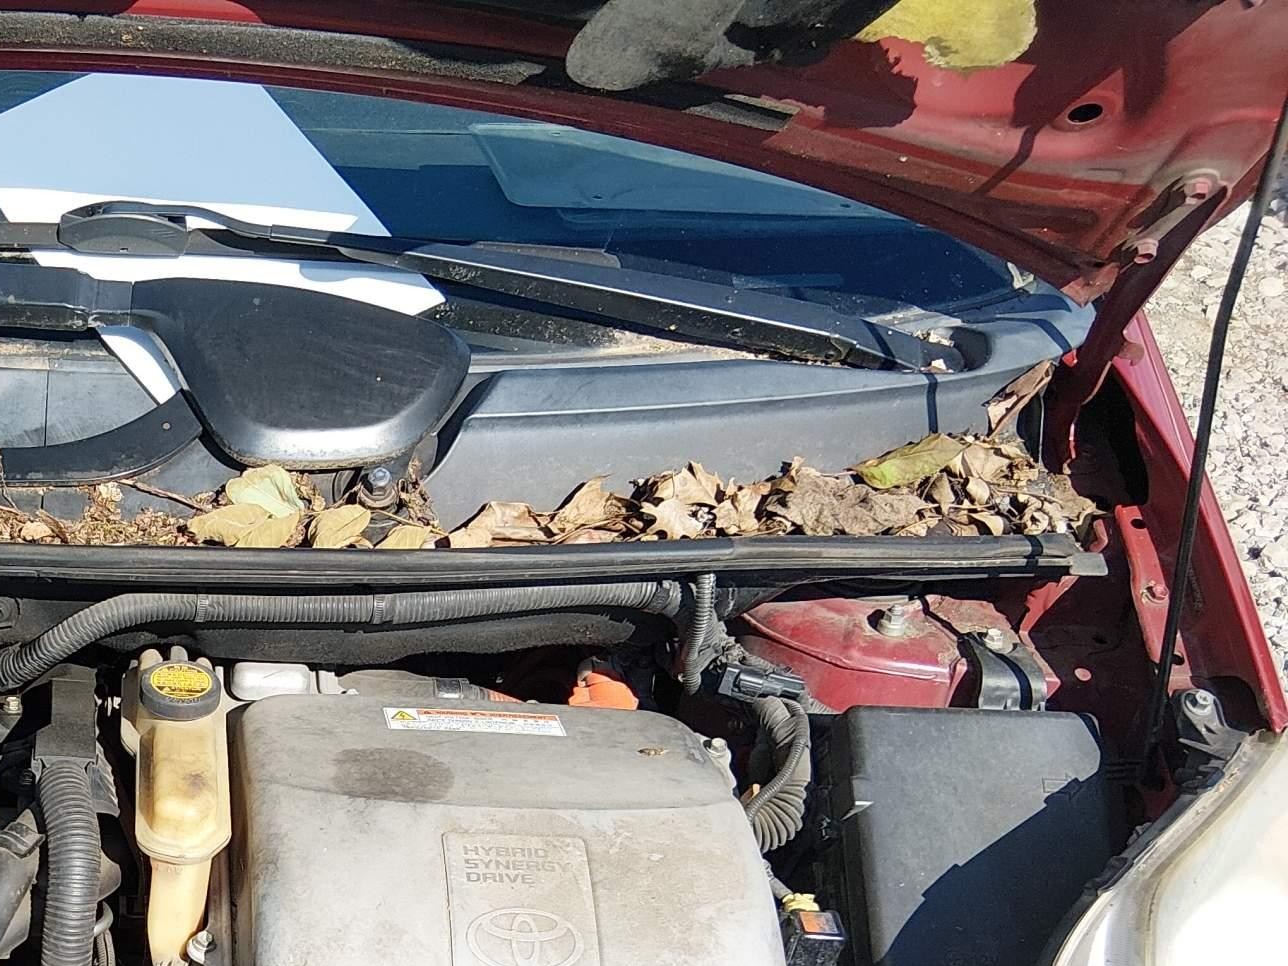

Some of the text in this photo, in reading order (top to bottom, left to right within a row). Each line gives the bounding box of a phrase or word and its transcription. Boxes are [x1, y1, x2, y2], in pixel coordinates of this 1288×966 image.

[463, 845, 548, 859] HYBRID
[464, 859, 571, 872] SYNERGY
[466, 871, 535, 885] DRIVE
